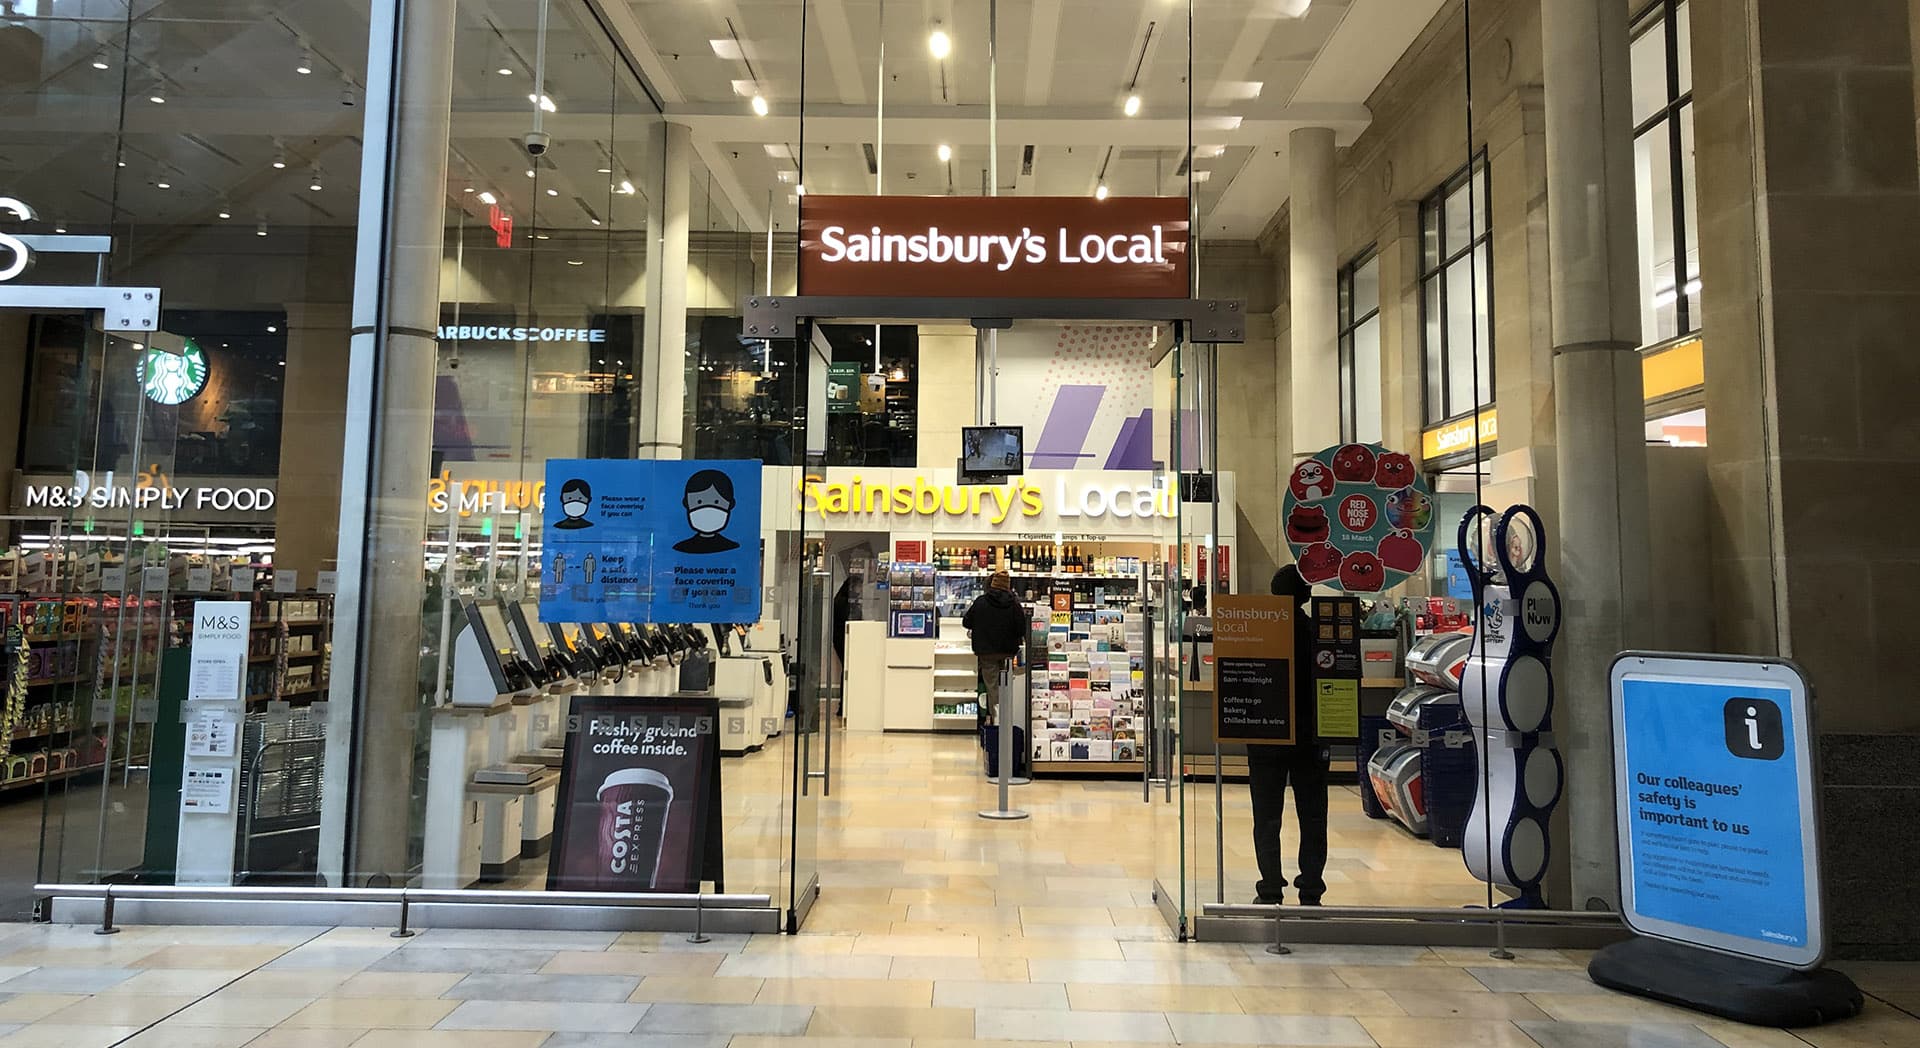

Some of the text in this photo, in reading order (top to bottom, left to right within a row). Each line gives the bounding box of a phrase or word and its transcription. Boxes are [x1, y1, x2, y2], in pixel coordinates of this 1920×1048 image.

[820, 225, 1165, 271] Sainsbury's Local
[436, 326, 528, 342] ARBUCKS
[26, 485, 275, 511] M&S SIMPLY FOOD
[797, 475, 1044, 524] Sainsbury's
[1350, 500, 1366, 509] RED
[616, 503, 644, 511] covering
[1347, 508, 1369, 519] NOSE
[1350, 517, 1366, 527] DAY
[1351, 534, 1374, 542] March
[602, 555, 624, 564] Keep
[674, 566, 737, 575] Please wear a
[601, 576, 638, 584] distance
[674, 576, 736, 588] face covering
[1216, 607, 1289, 622] Sainsbury's
[201, 615, 240, 630] M&S
[1216, 621, 1249, 633] Local
[1242, 677, 1272, 685] midnight
[1223, 696, 1244, 704] Coffee
[1223, 707, 1246, 715] Bakery
[589, 720, 640, 742] Feshy
[593, 738, 688, 755] coffee inside.
[1637, 772, 1743, 797] Our colleagues'
[1638, 791, 1697, 810] safety is
[1639, 807, 1750, 835] important to us
[630, 799, 645, 861] EXPRESS
[610, 800, 633, 874] COSTA
